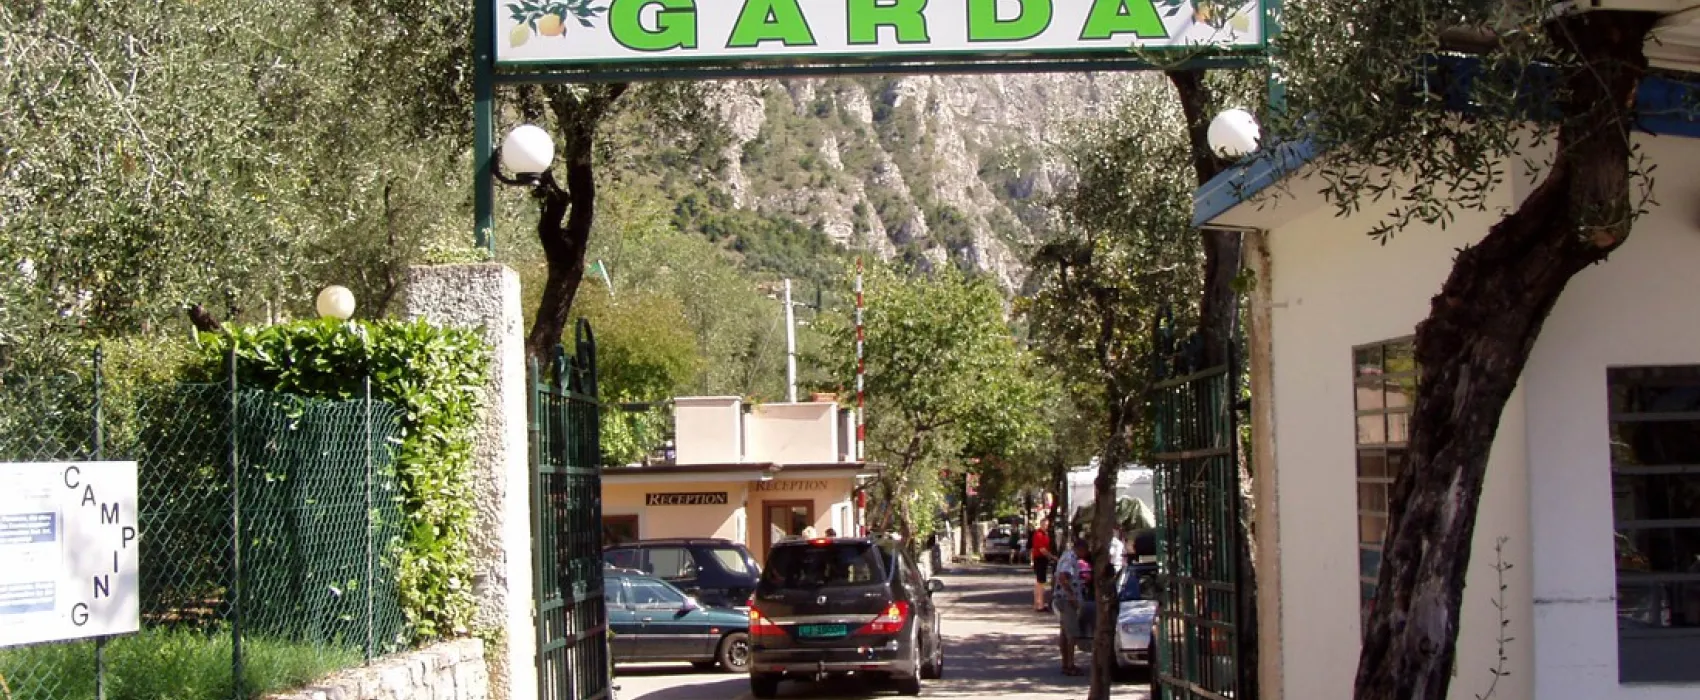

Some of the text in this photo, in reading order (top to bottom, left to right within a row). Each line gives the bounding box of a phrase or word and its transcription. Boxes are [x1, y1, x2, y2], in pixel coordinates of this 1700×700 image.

[608, 0, 1170, 51] GARDA
[649, 493, 726, 505] RECEPTION
[755, 480, 829, 492] RECEPTION
[64, 465, 136, 627] CAMPING
